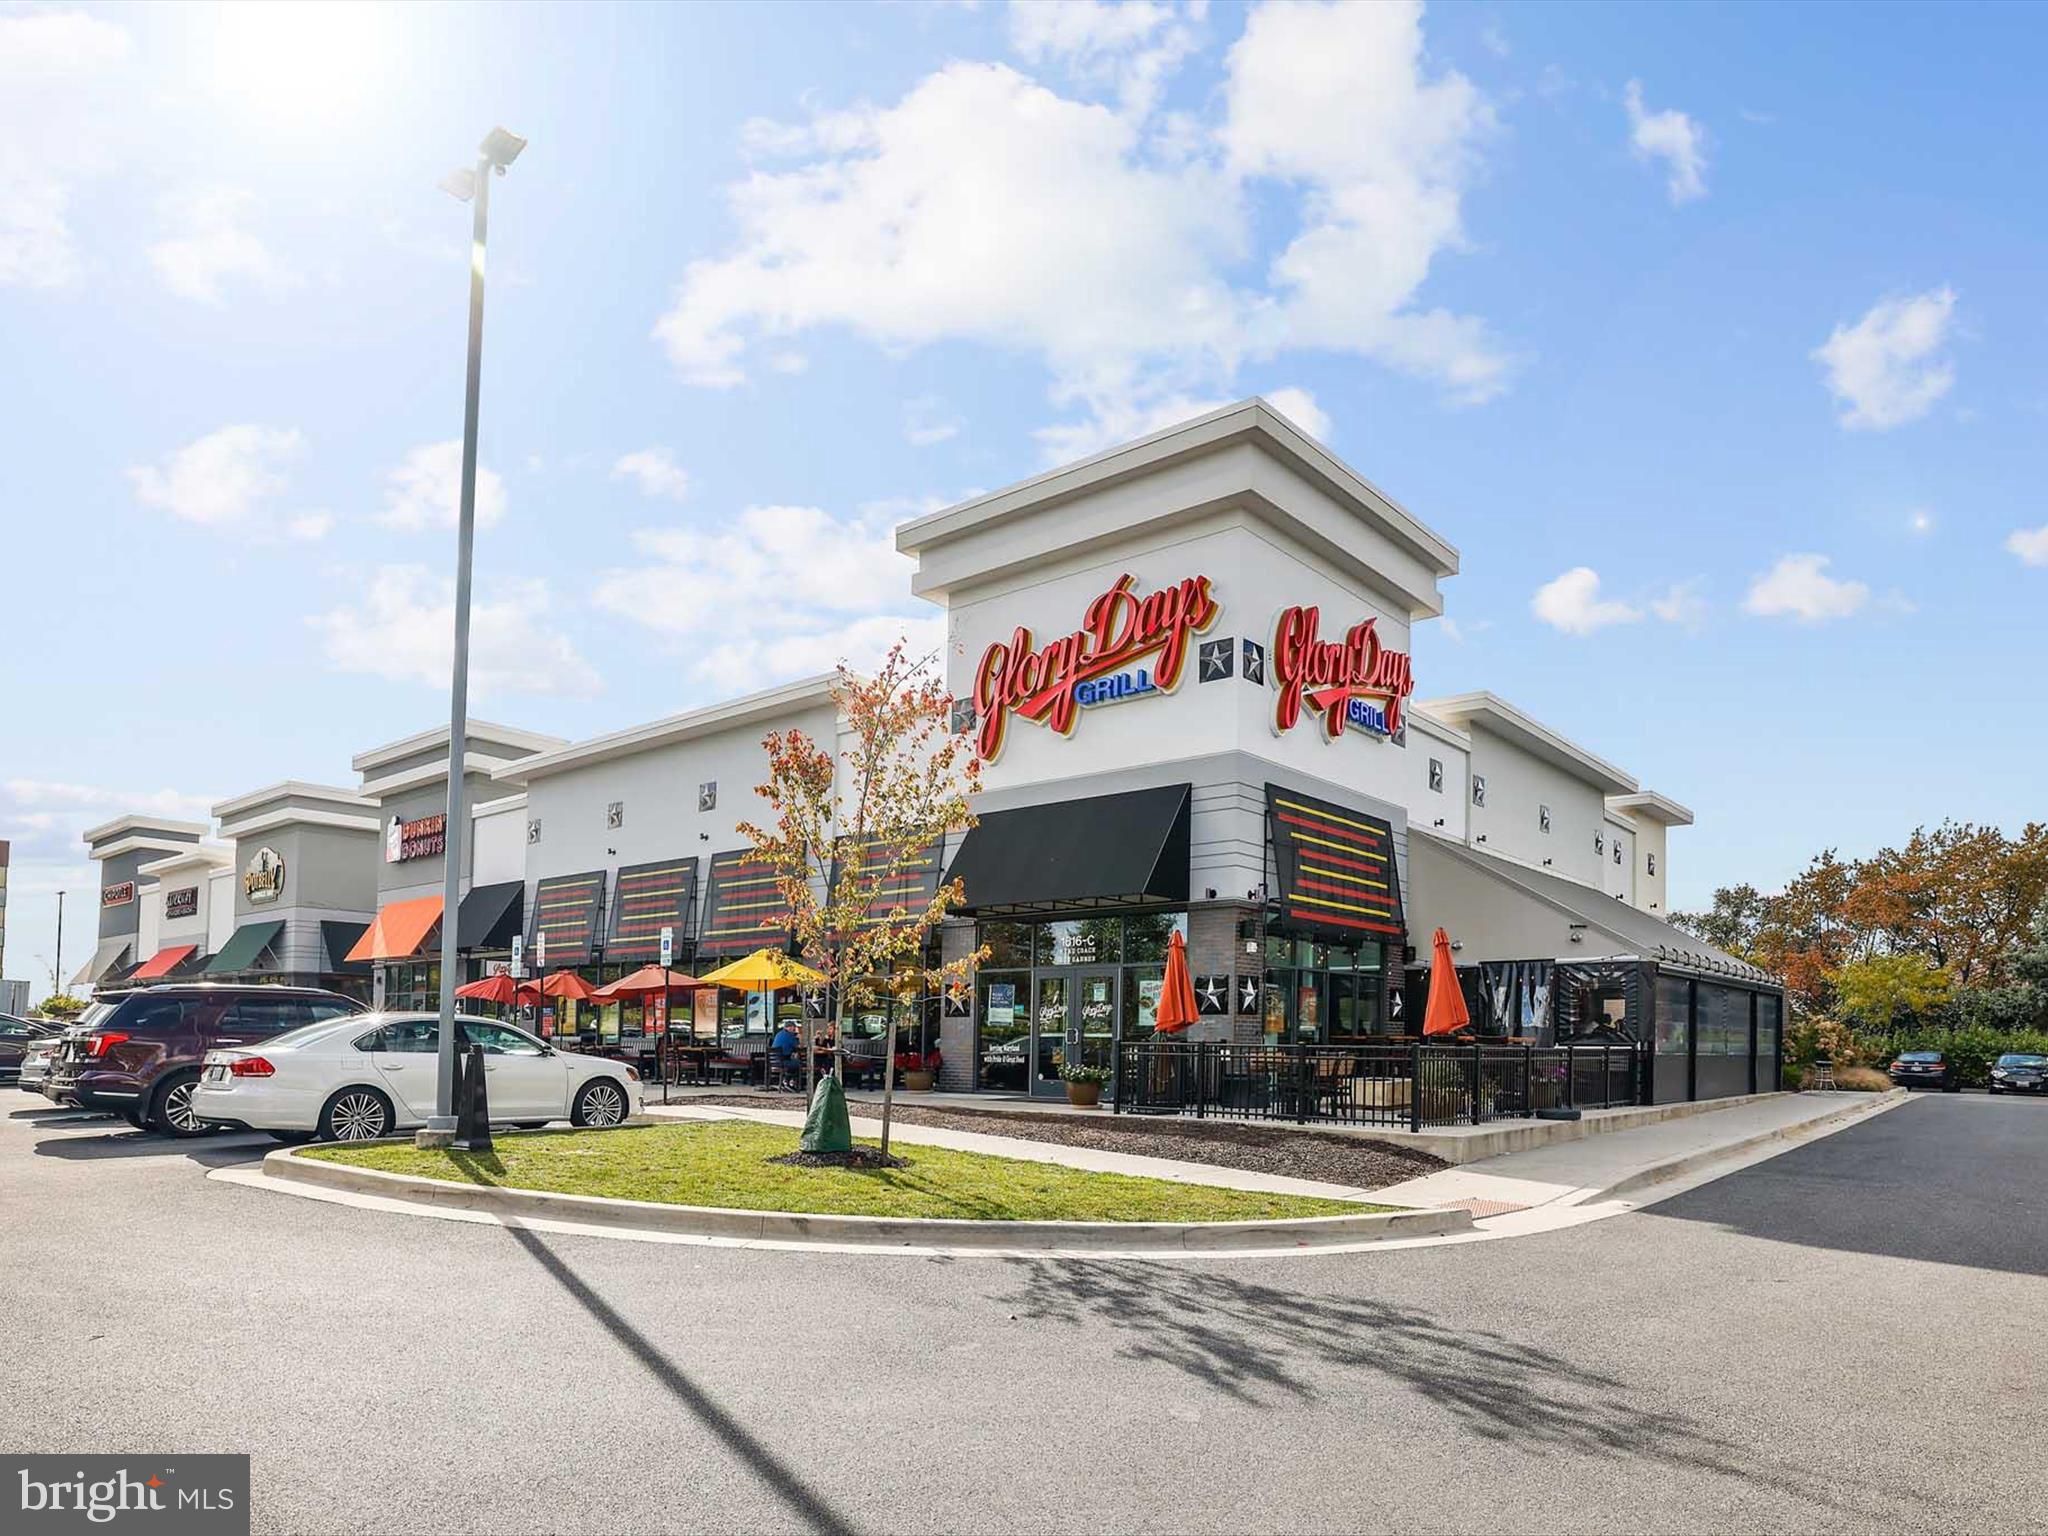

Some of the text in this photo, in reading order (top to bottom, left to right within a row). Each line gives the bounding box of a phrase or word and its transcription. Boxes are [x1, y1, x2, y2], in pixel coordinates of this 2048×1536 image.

[972, 572, 1220, 763] Glory Days
[1274, 605, 1414, 737] Glory Days
[1074, 668, 1157, 705] GRILL
[1347, 698, 1391, 735] GRILL
[401, 835, 443, 859] DONUTS
